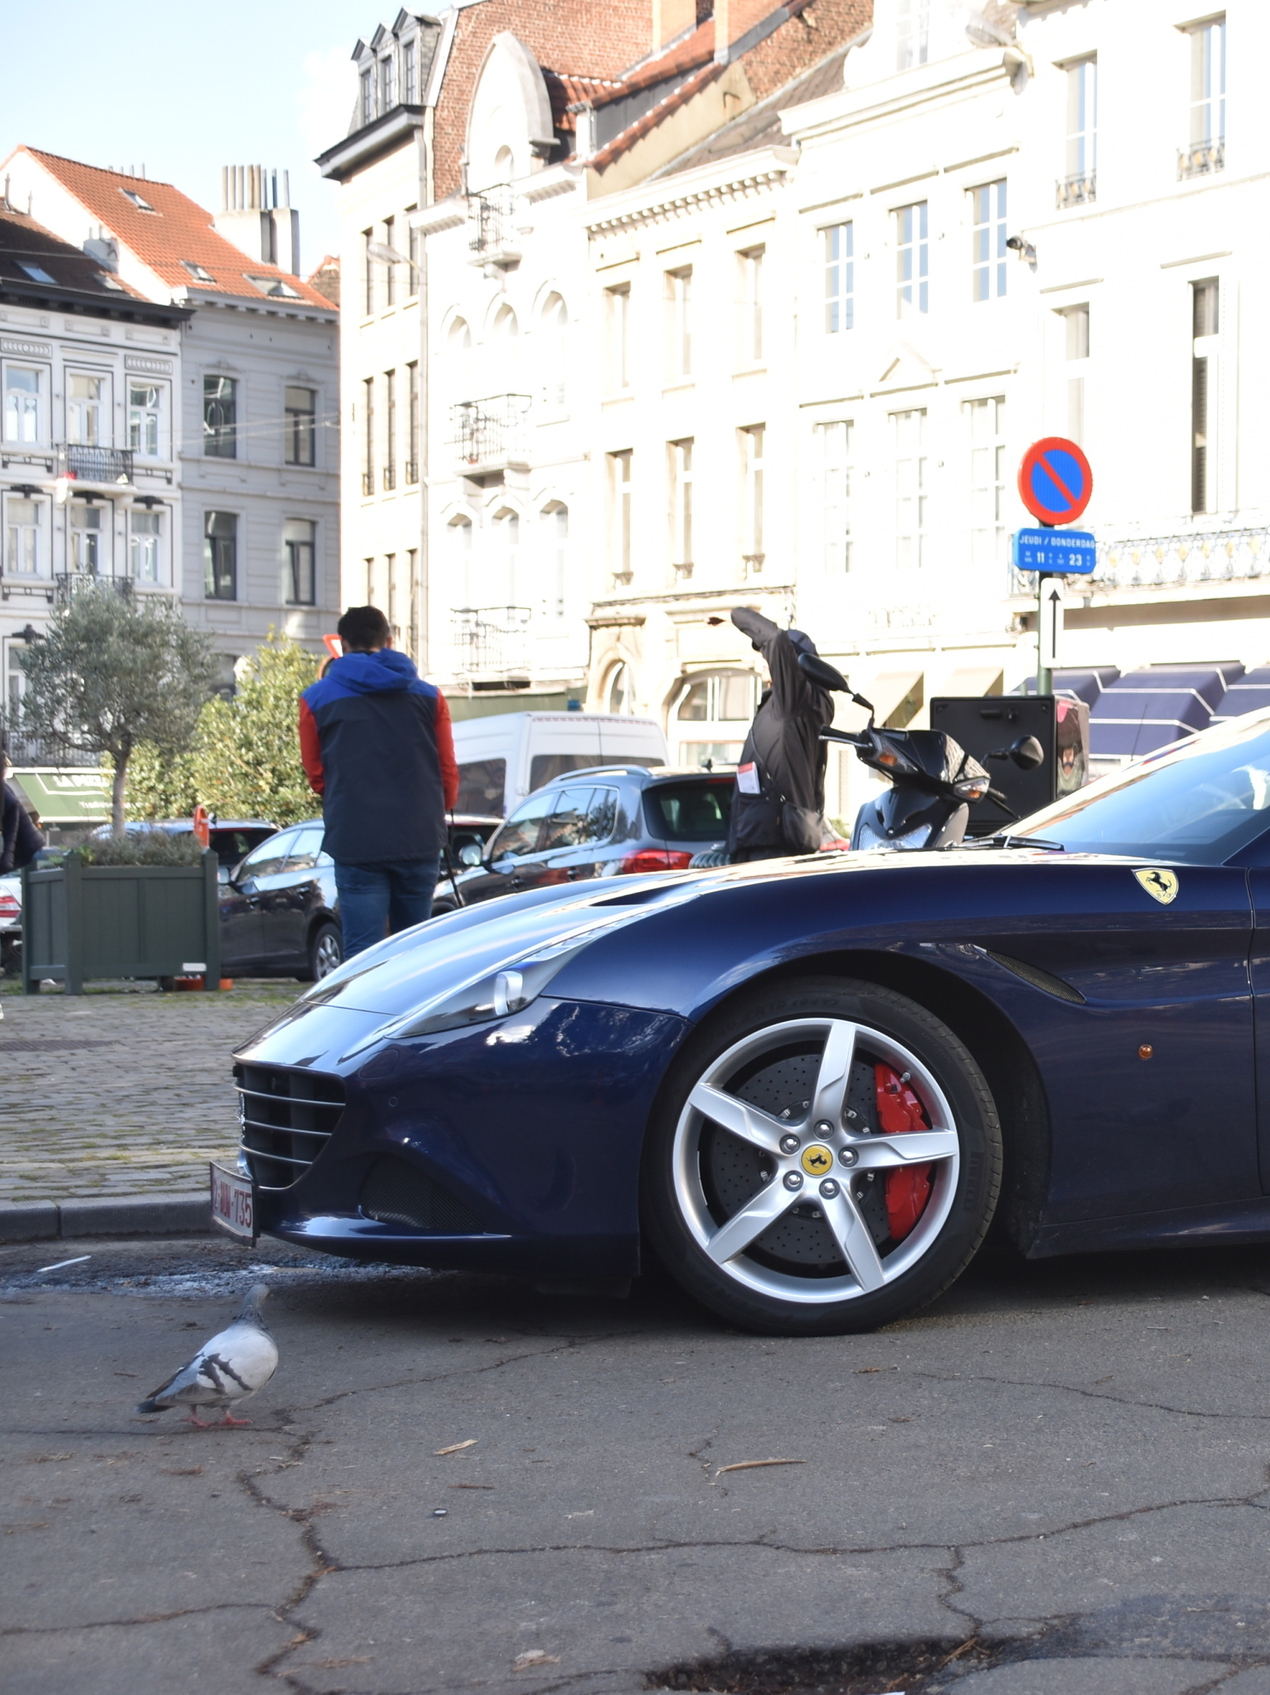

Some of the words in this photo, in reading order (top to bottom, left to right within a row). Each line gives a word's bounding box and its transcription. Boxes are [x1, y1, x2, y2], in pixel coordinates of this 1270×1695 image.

[1020, 535, 1042, 546] JEUDI
[1051, 537, 1095, 549] DONDERDAG
[1037, 551, 1045, 564] 11
[1069, 553, 1083, 567] 23
